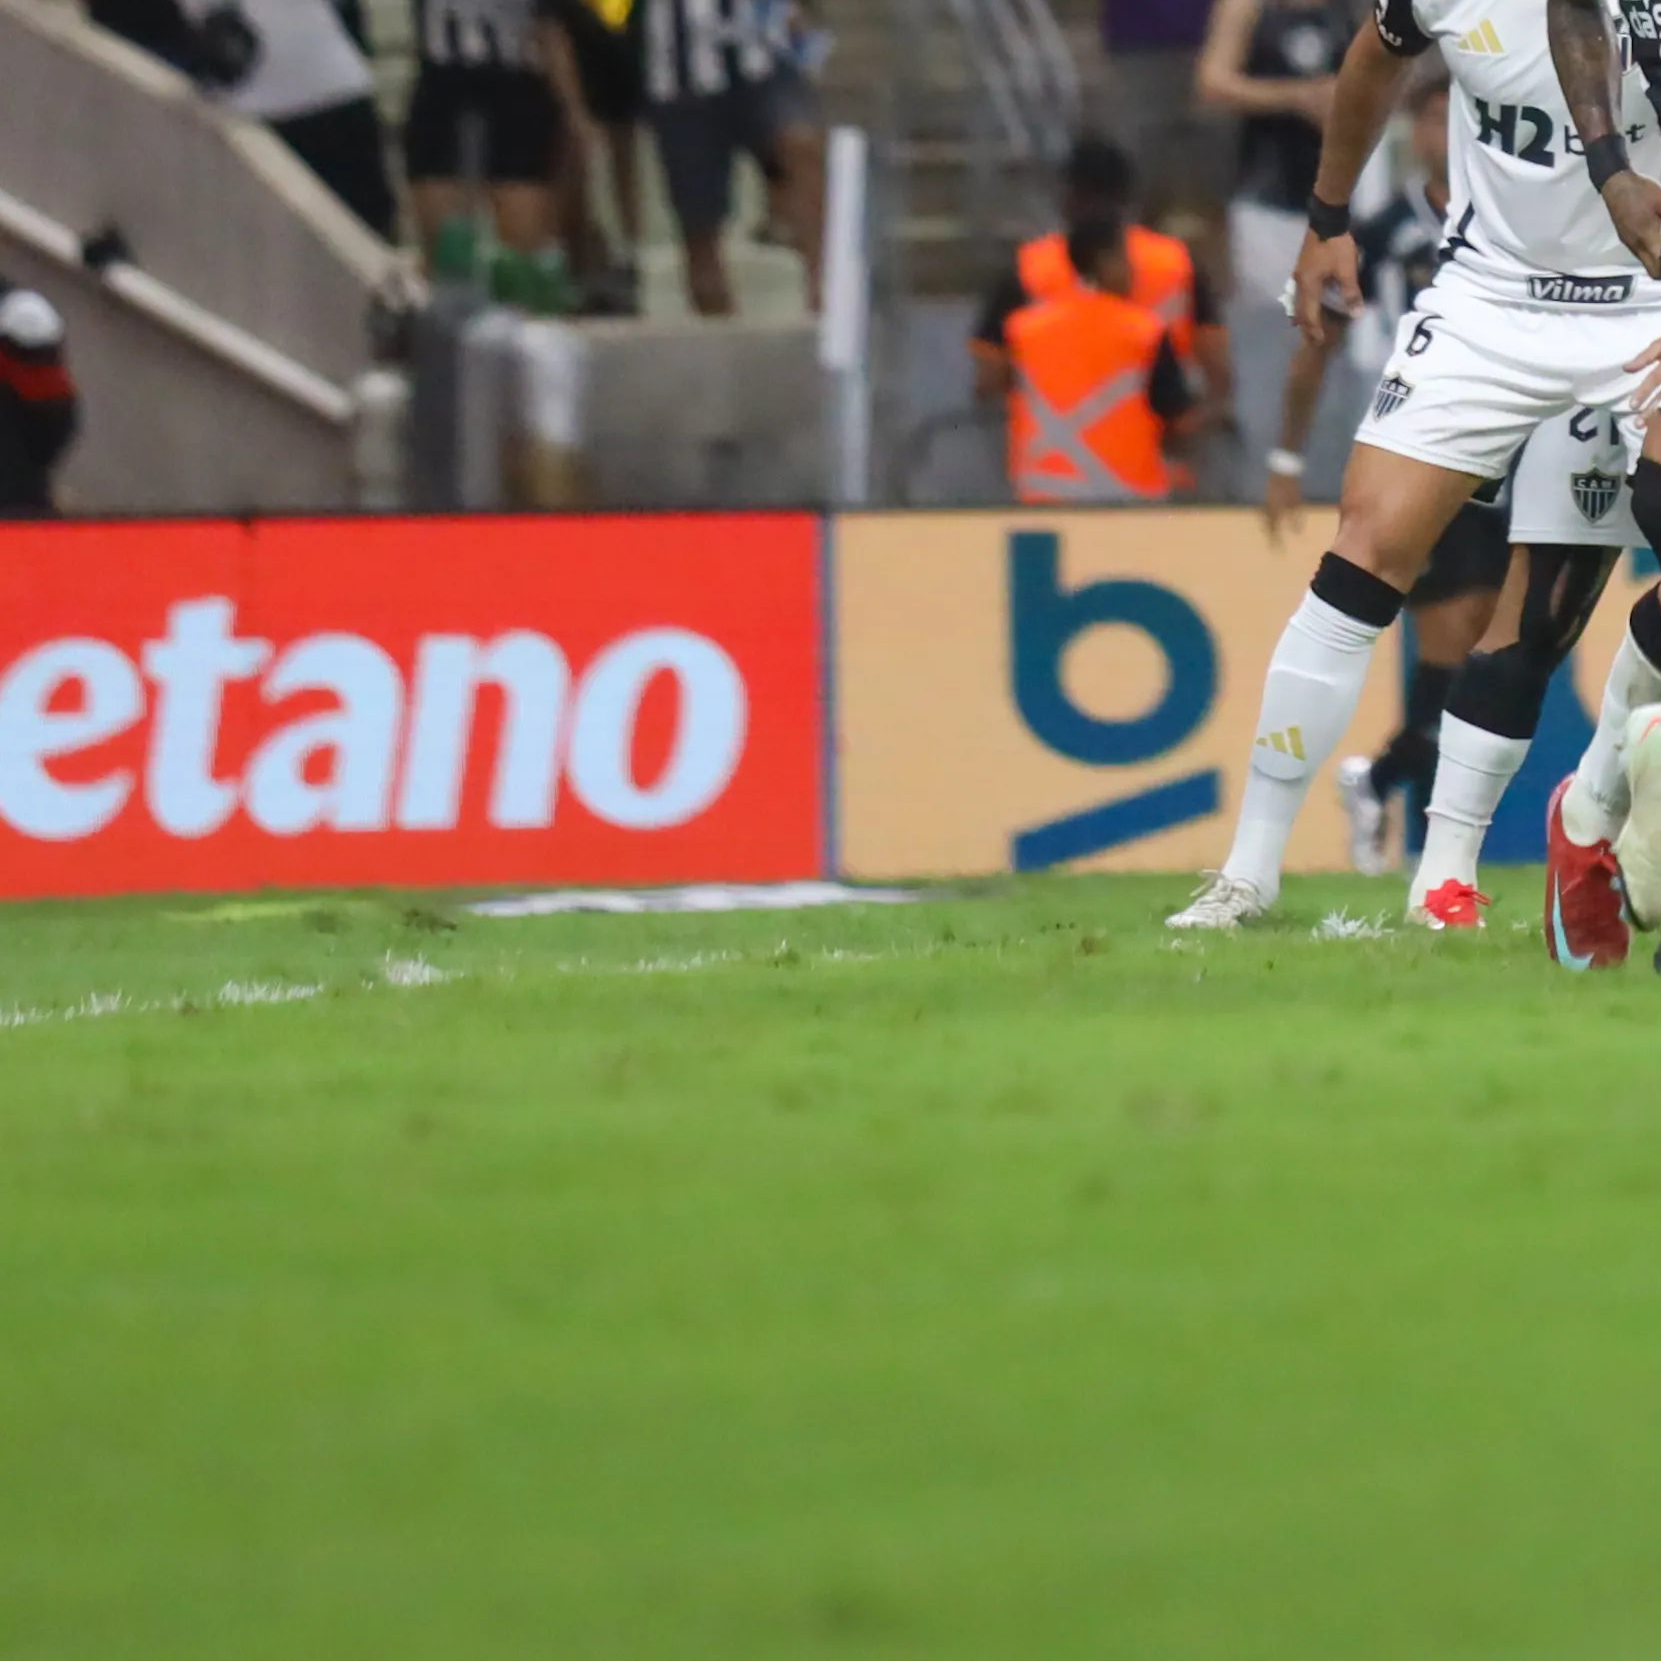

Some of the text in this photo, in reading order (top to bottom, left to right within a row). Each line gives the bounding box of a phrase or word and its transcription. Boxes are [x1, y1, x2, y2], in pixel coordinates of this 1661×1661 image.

[1531, 275, 1626, 304] Vilma
[1405, 315, 1444, 357] 6
[1575, 477, 1616, 490] CAM
[0, 595, 748, 840] etano
